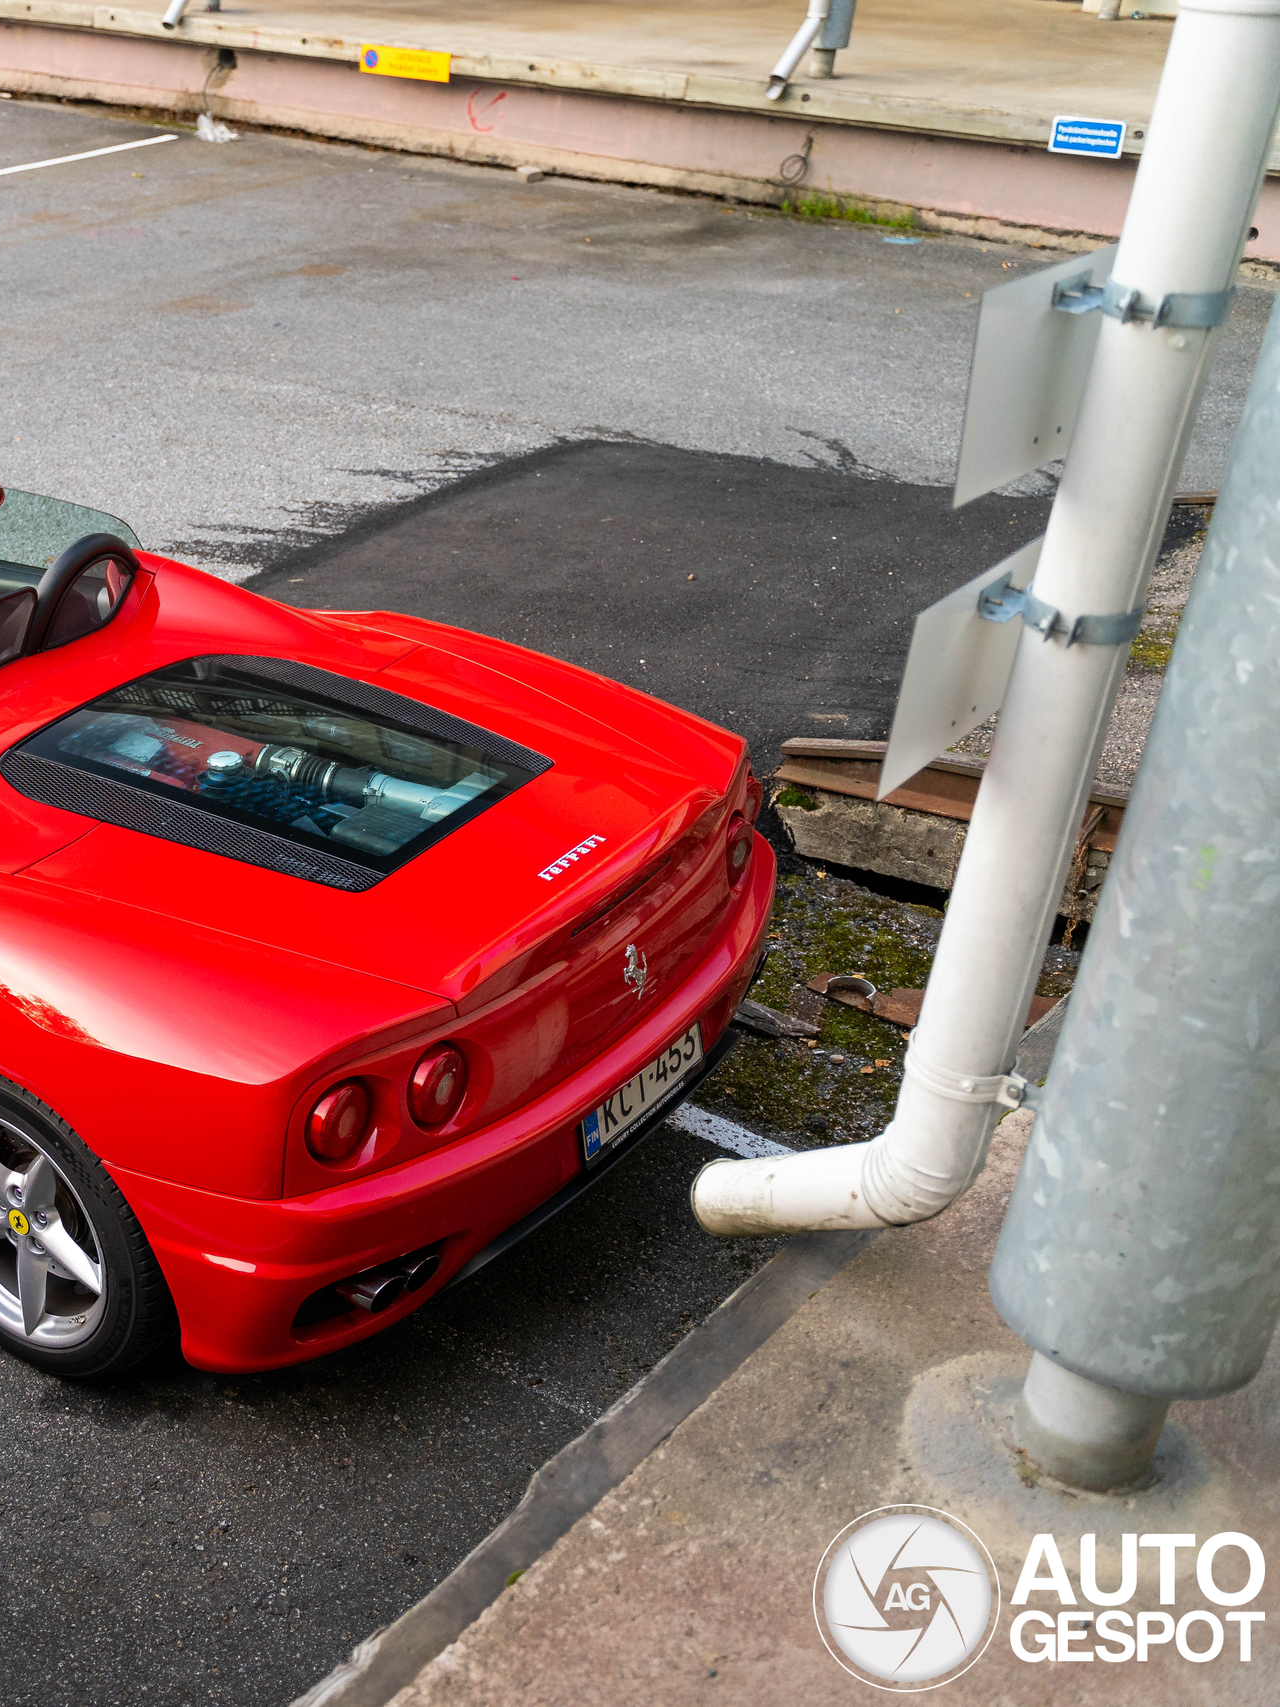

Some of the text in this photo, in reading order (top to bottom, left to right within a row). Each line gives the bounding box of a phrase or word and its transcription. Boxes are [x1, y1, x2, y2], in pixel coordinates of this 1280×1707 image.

[537, 834, 607, 881] Ferrari
[586, 1128, 600, 1147] FIN
[611, 1080, 685, 1148] LUXURY COLLECTION AUTOMOBILES
